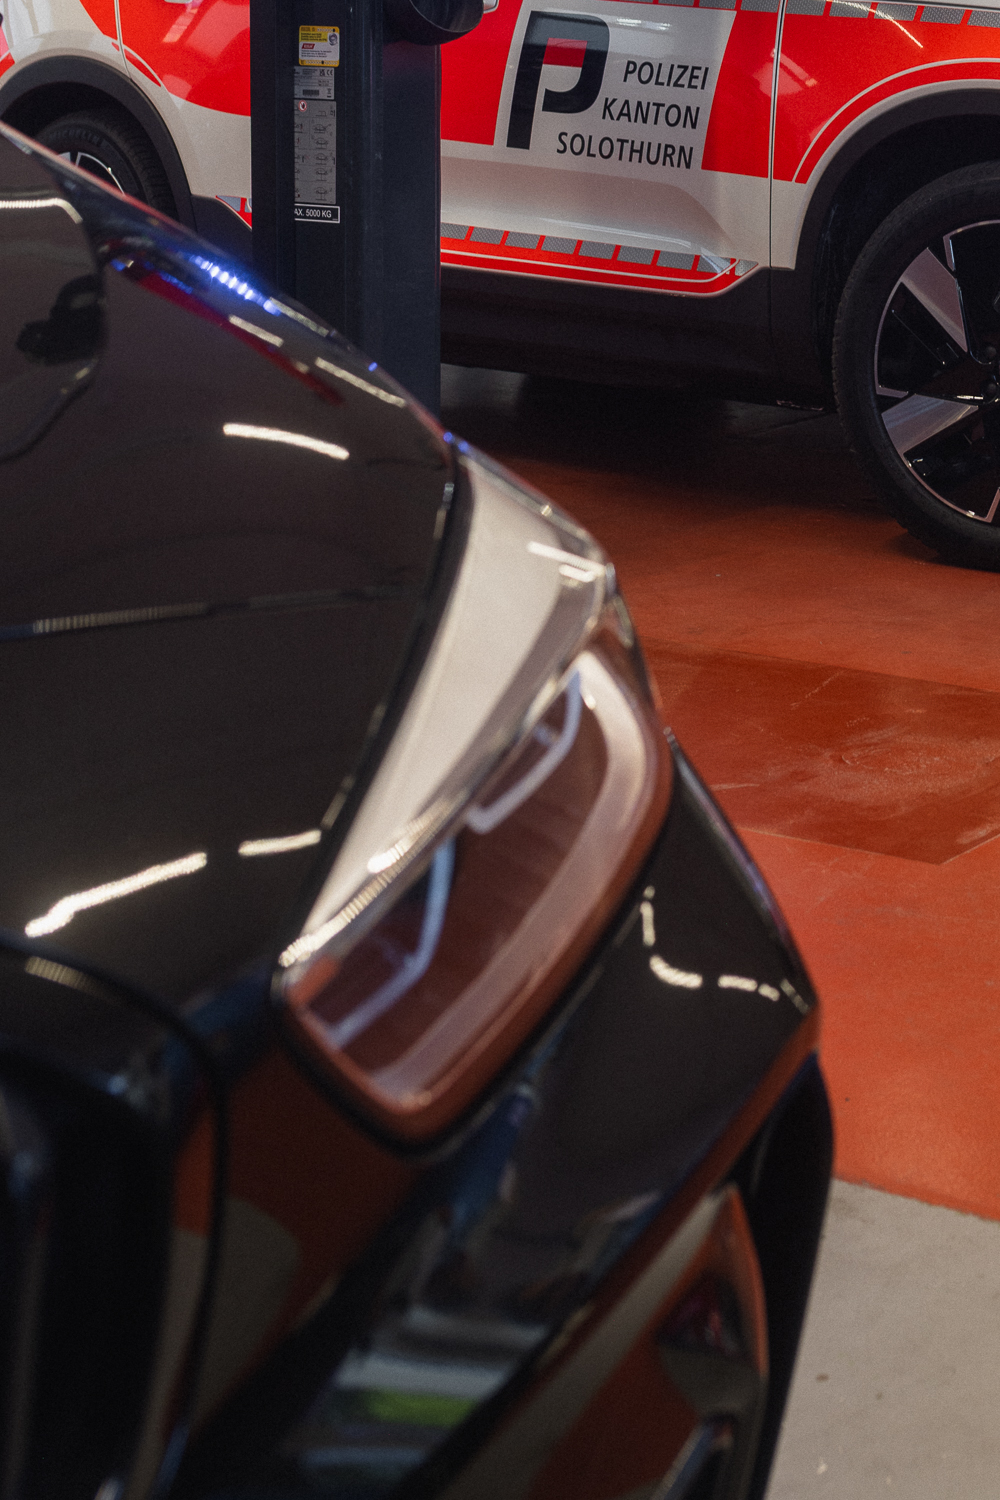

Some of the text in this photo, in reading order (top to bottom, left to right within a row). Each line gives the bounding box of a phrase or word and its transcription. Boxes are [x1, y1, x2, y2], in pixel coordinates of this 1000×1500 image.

[623, 60, 709, 90] POLIZEI
[601, 97, 700, 130] KANTON
[556, 131, 694, 169] SOLOTHURN
[305, 208, 321, 218] 5000
[322, 210, 332, 219] KG
